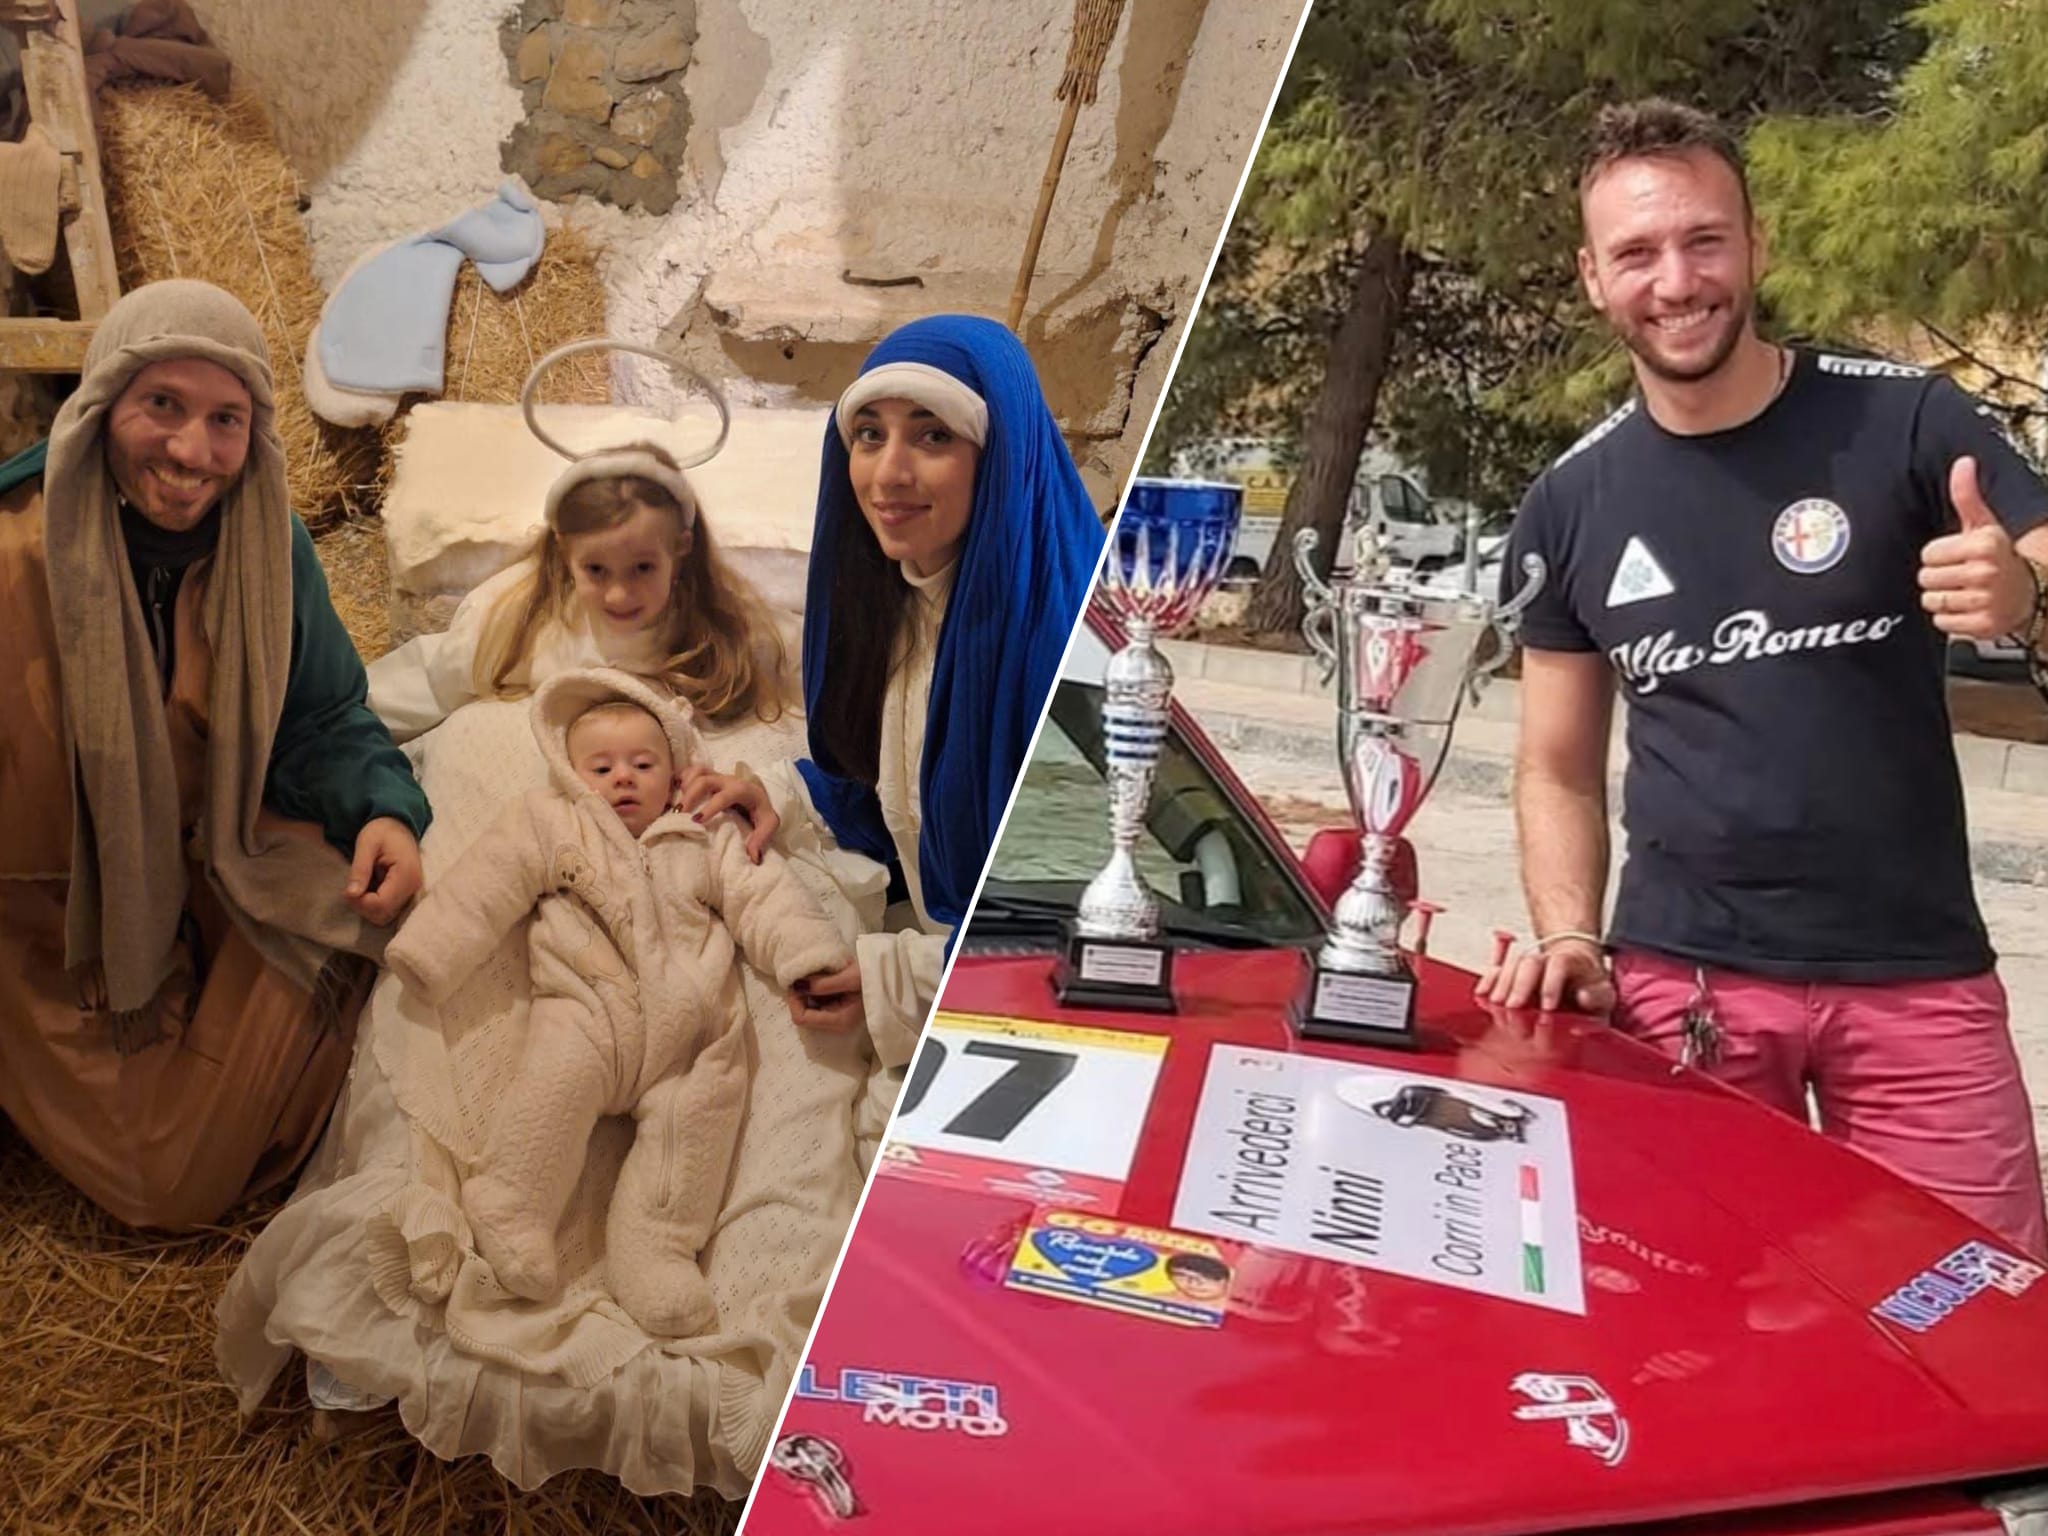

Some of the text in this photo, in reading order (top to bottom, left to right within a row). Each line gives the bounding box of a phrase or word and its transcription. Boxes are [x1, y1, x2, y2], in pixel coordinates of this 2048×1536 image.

[1609, 609, 1905, 694] Alfa Romeo
[1208, 1088, 1296, 1236] Arrivederci
[1309, 1164, 1384, 1256] Ninni
[1431, 1142, 1484, 1277] Corri in Pace
[863, 1398, 1009, 1437] MOTO
